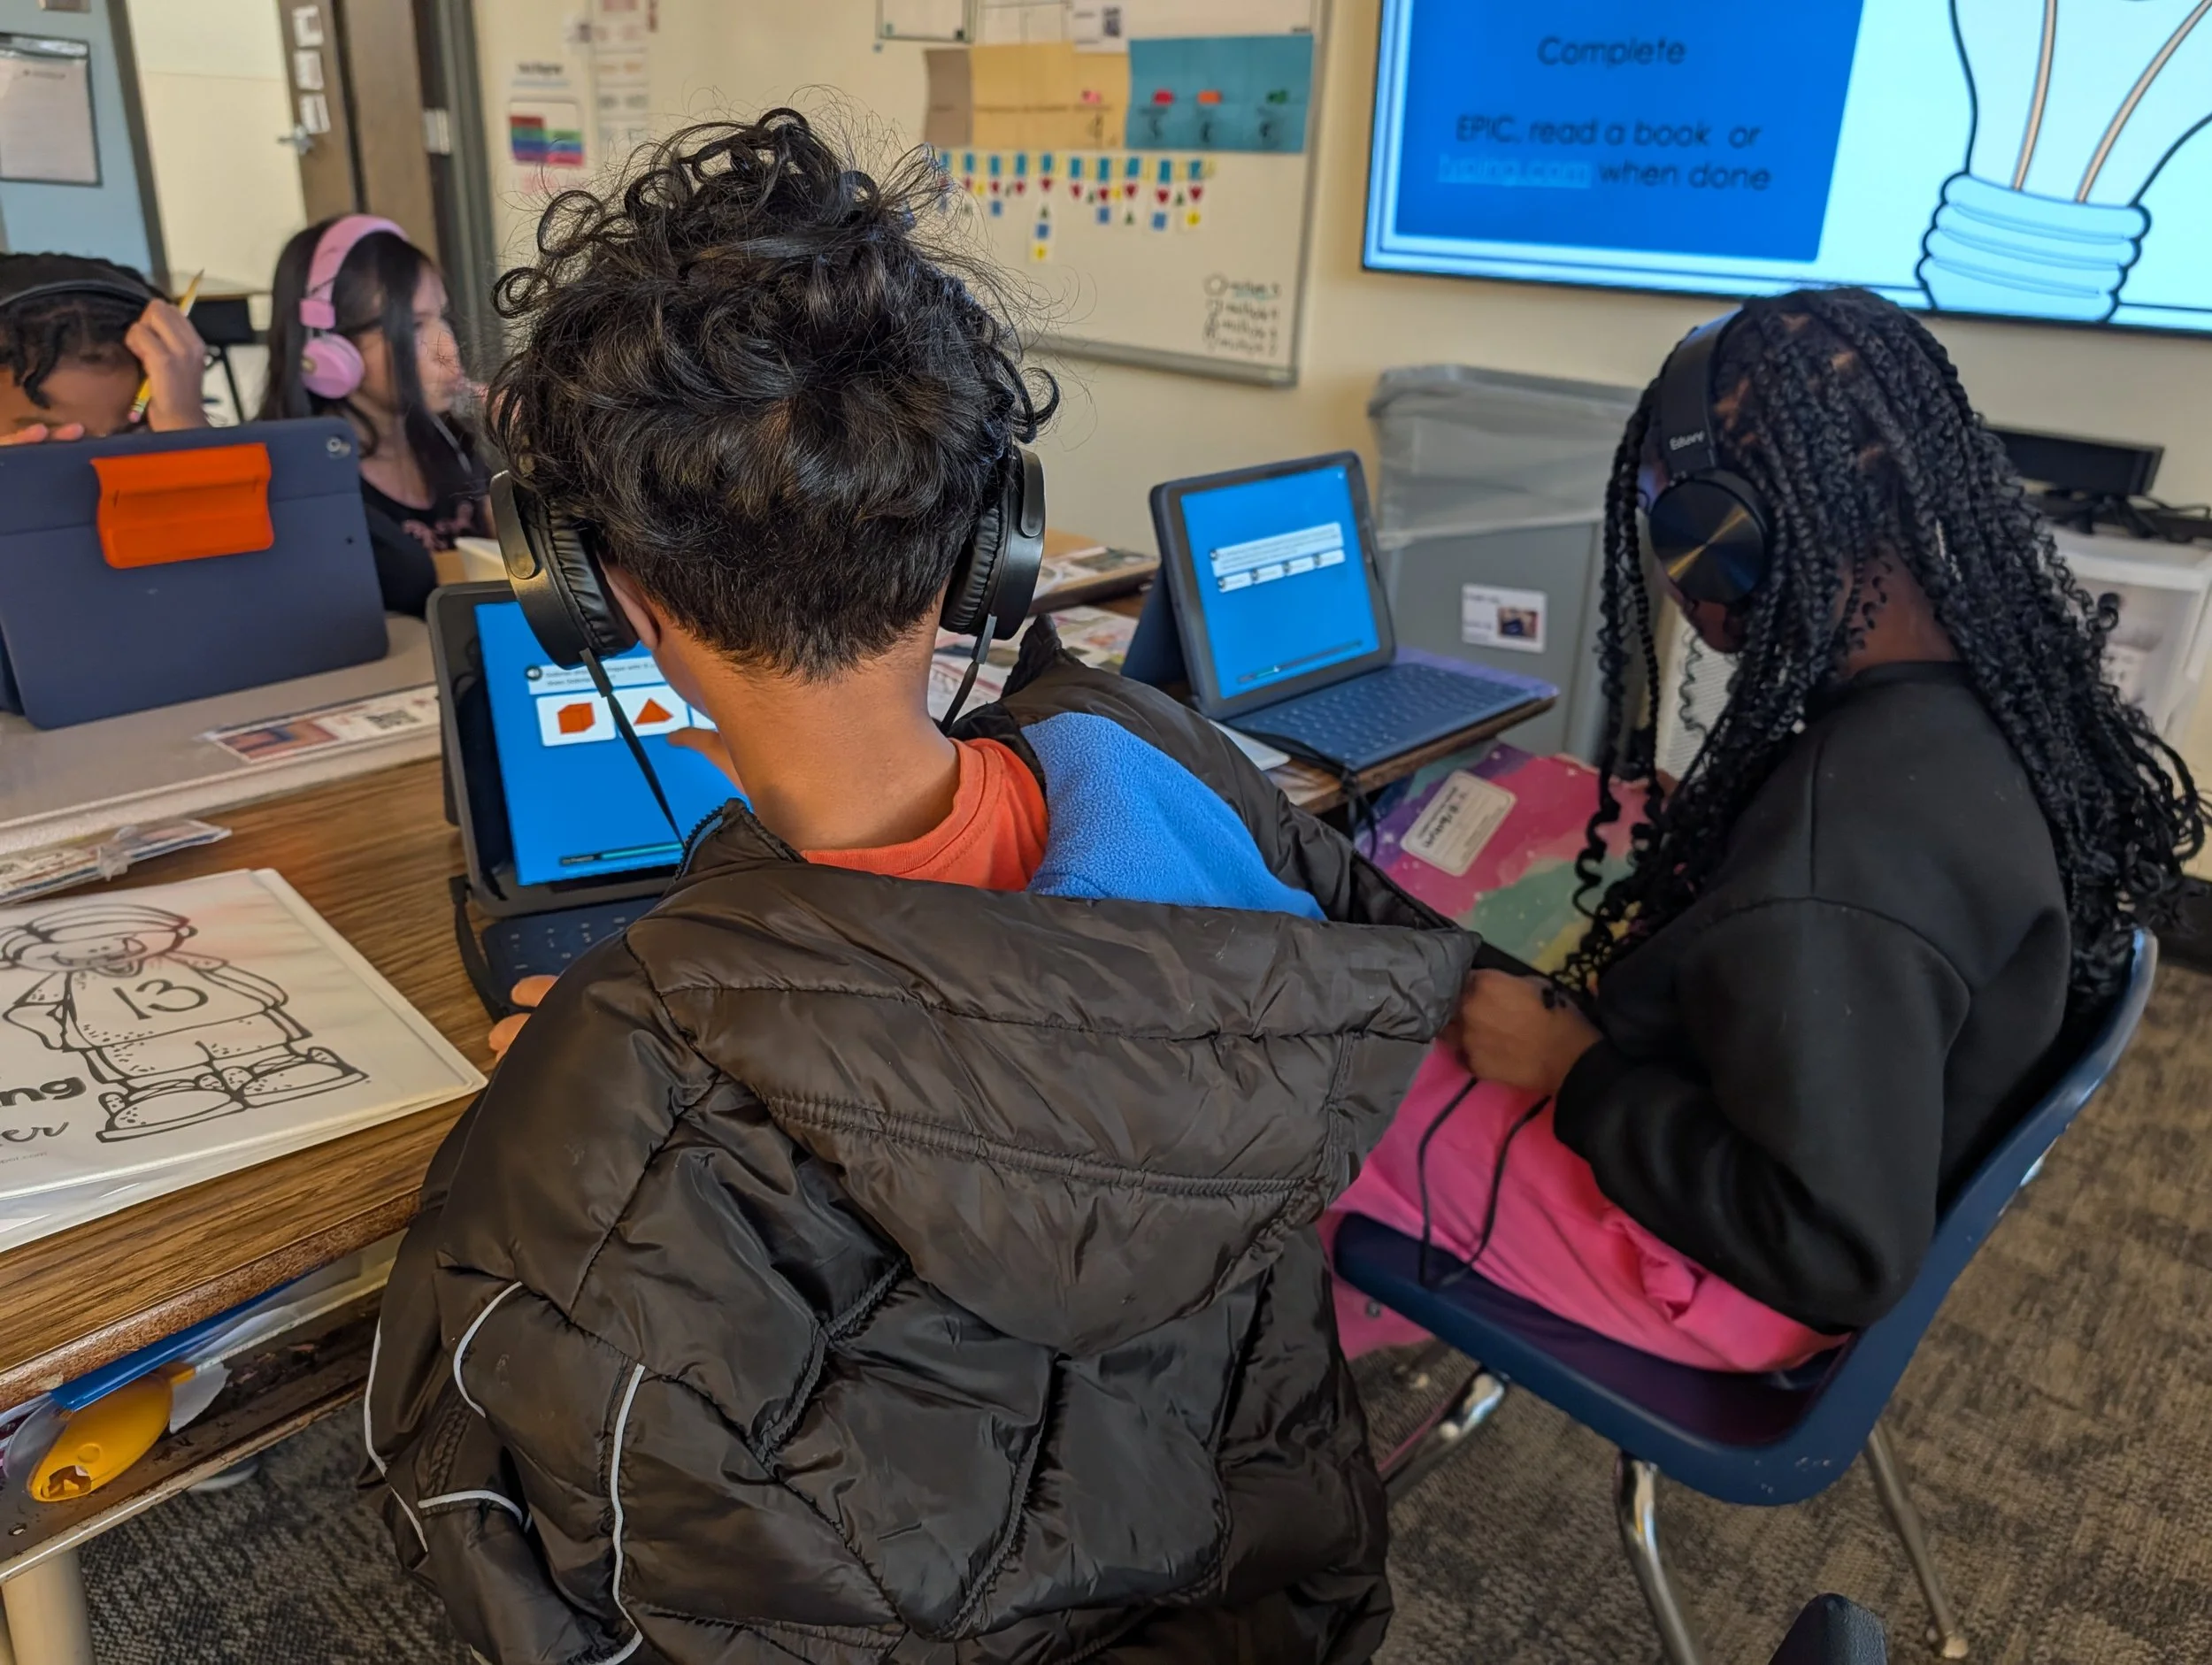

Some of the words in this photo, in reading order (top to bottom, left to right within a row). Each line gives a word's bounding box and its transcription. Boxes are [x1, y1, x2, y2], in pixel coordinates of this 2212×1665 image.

[1536, 35, 1688, 68] Complete
[1528, 118, 1599, 146] read
[1603, 122, 1626, 147] a
[1633, 119, 1712, 148] book
[1727, 124, 1762, 149] or
[1598, 158, 1678, 187] when
[1687, 161, 1771, 191] done
[111, 978, 209, 1020] 13
[0, 1076, 87, 1107] ng
